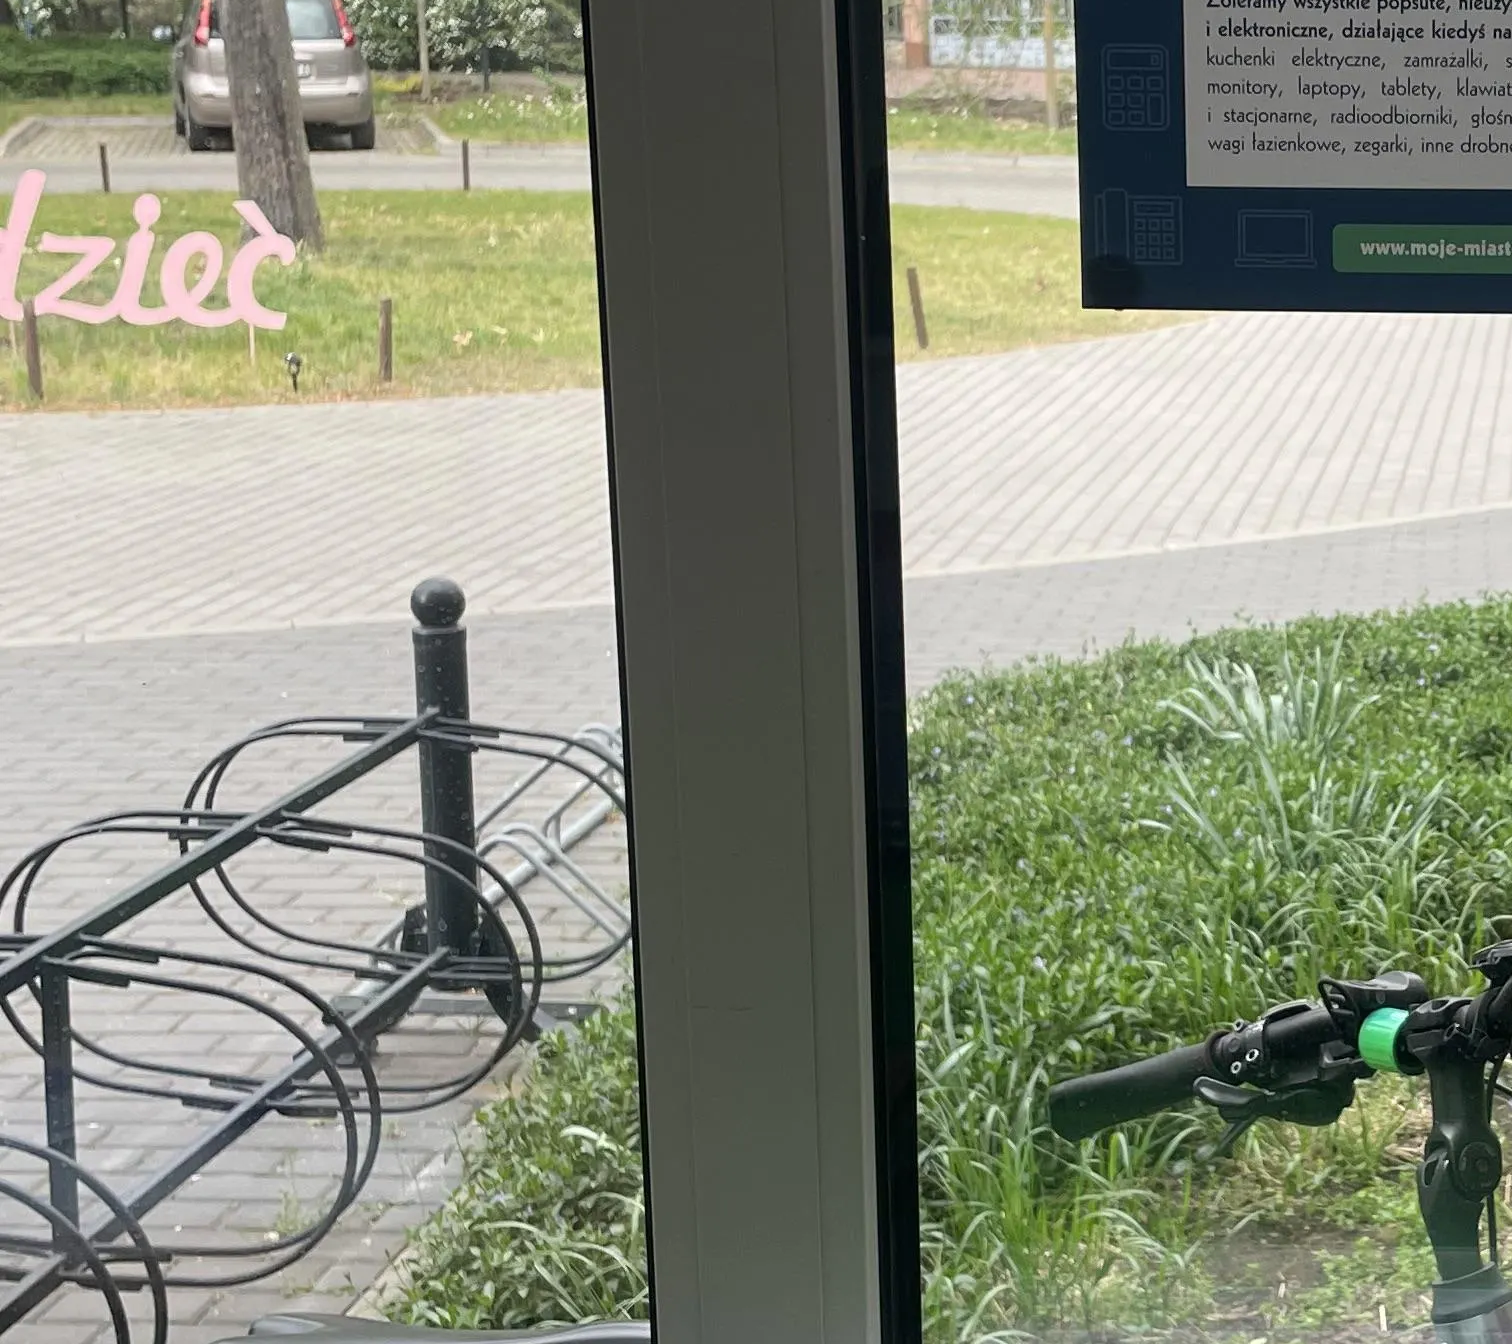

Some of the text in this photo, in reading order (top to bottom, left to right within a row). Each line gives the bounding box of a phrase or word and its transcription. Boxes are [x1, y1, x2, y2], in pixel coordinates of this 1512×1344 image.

[1206, 20, 1211, 38] i
[1217, 16, 1334, 42] elektroniczne,
[1341, 17, 1425, 44] działające
[1431, 18, 1486, 45] kiedyś
[1492, 26, 1512, 40] na
[1206, 45, 1275, 68] kuchenki
[1291, 45, 1386, 72] elektryczne,
[1403, 46, 1489, 72] zamrażalki,
[1207, 78, 1283, 100] monitory,
[1298, 74, 1366, 100] laptopy,
[1381, 75, 1442, 102] tablety,
[1207, 106, 1212, 124] i
[1223, 107, 1318, 128] stacjonarne,
[1330, 102, 1458, 129] radioodbiorniki,
[1207, 135, 1245, 156] wagi
[1252, 130, 1346, 156] łazienkowe,
[1353, 132, 1413, 158] zegarki,
[1420, 136, 1455, 154] inne
